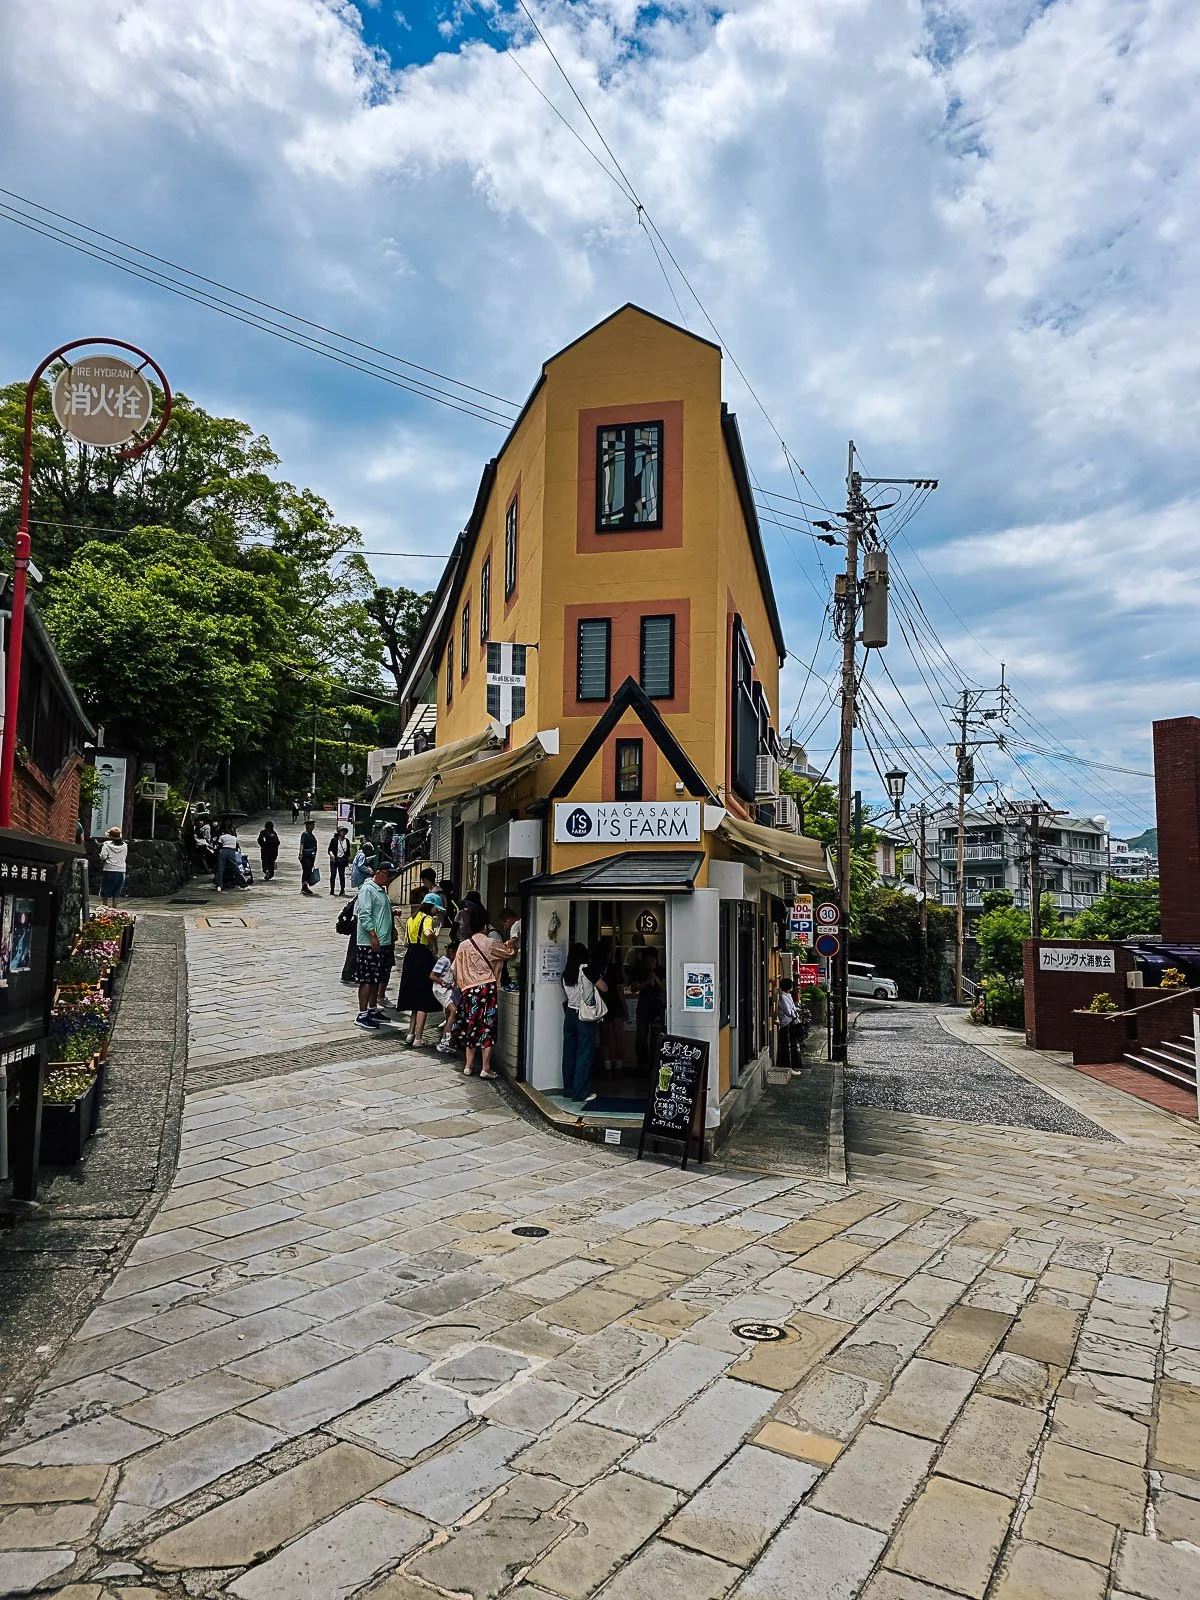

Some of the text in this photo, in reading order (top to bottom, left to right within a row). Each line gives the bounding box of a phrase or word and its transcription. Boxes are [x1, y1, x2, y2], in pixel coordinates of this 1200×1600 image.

[71, 366, 135, 379] FIRE HYDRANT
[63, 382, 143, 419] 消火栓
[597, 807, 688, 818] NAGASAKI
[572, 814, 587, 829] I'S
[597, 818, 689, 837] I'S FARM
[640, 915, 653, 928] I'S
[821, 909, 834, 920] 30
[800, 921, 810, 931] P
[1042, 952, 1112, 968] カトリック大浦教会
[660, 1041, 702, 1060] 長崎名物
